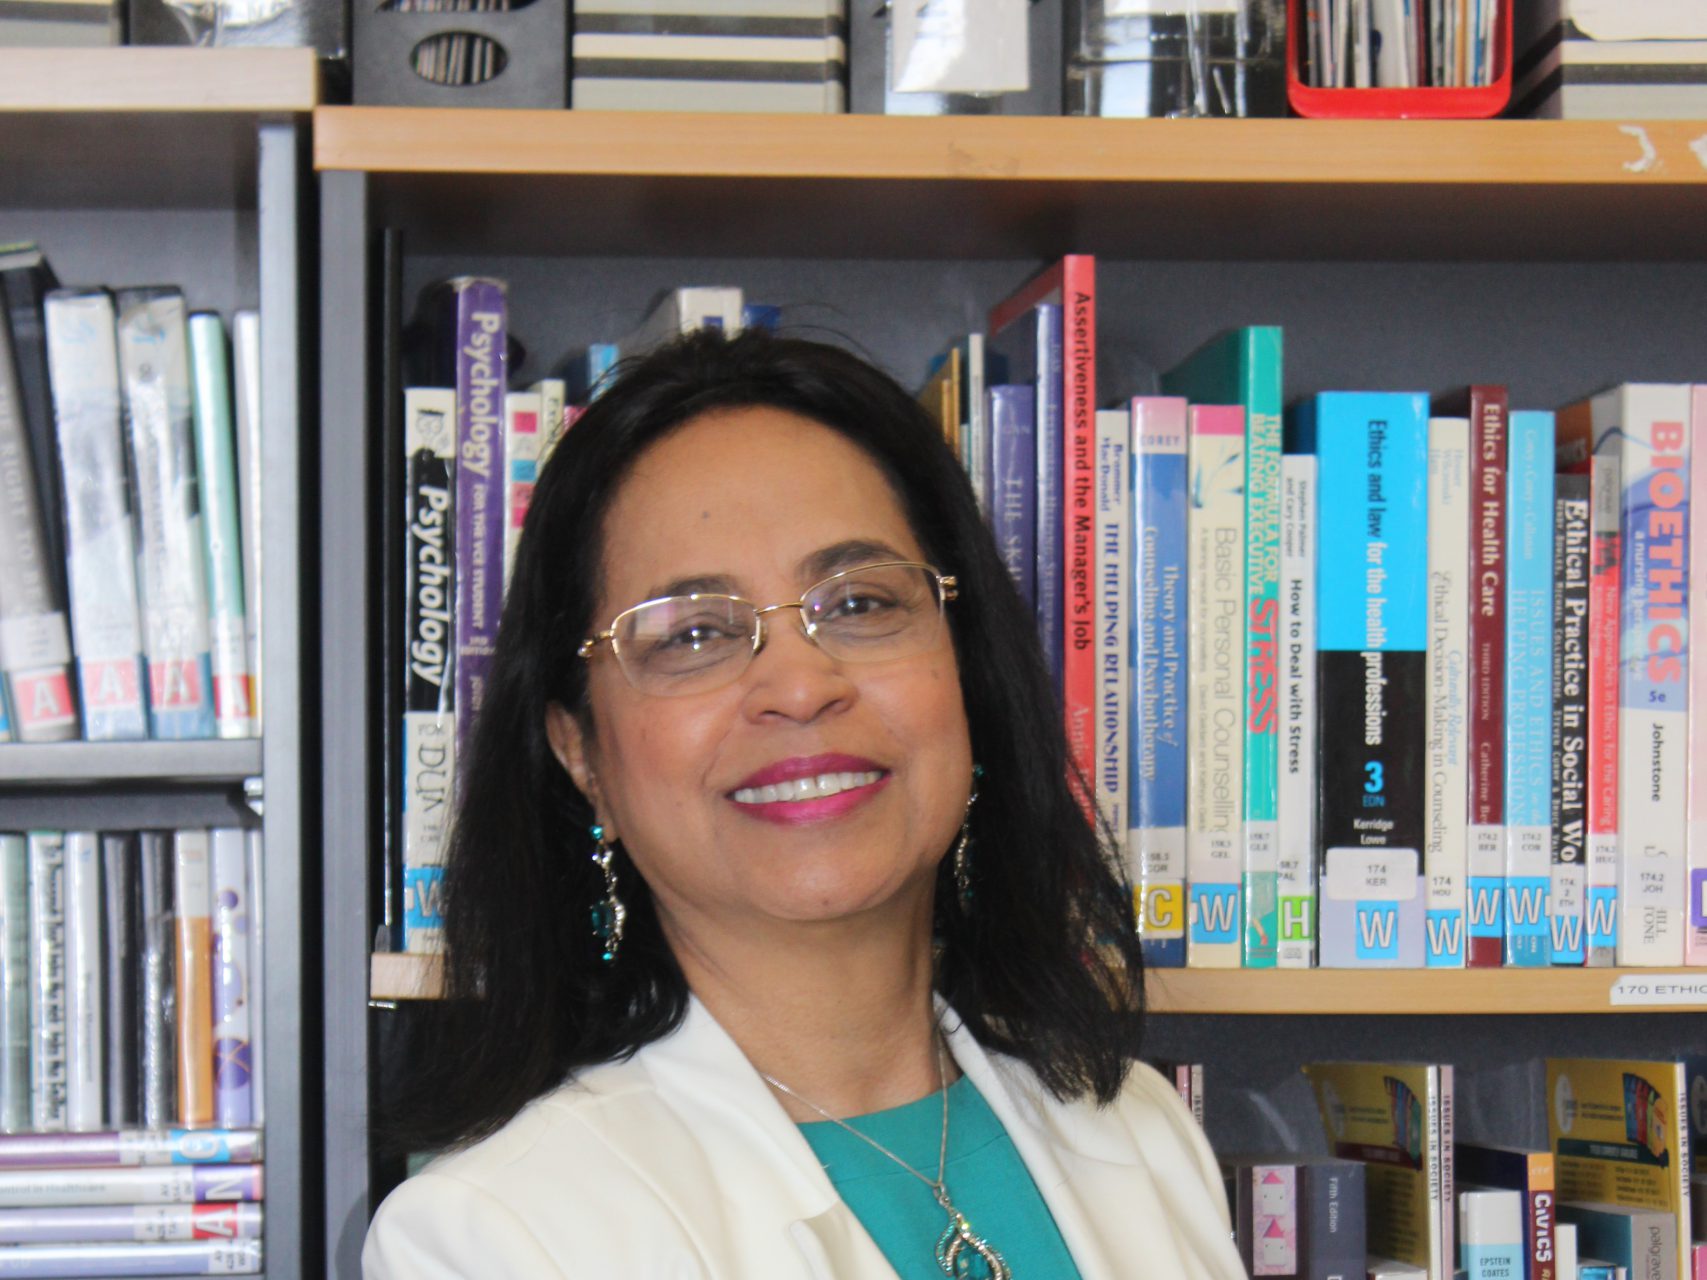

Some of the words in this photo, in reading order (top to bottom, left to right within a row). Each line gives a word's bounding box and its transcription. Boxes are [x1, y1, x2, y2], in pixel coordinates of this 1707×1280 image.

[1074, 292, 1091, 429] Assertiveness
[461, 311, 499, 478] Psychology
[1367, 420, 1387, 468] Ethics
[1482, 403, 1501, 461] Ethics
[1075, 436, 1090, 470] and
[1074, 476, 1091, 507] the
[1264, 451, 1280, 539] FORMULA
[1367, 474, 1386, 502] and
[1483, 467, 1500, 494] for
[473, 514, 484, 537] THE
[1105, 523, 1119, 559] THE
[1368, 508, 1387, 537] law
[1482, 501, 1500, 565] Health
[1214, 527, 1237, 591] Basic
[1249, 498, 1264, 595] EXECUTIVE
[1367, 542, 1387, 564] for
[1564, 499, 1589, 589] Ethical
[1647, 420, 1685, 685] BIOETHICS
[1072, 514, 1091, 614] Manager's
[1265, 546, 1278, 582] FOR
[1367, 569, 1387, 594] the
[411, 485, 450, 687] Psychology
[473, 569, 484, 629] STUDENT
[1161, 565, 1179, 622] Theory
[1289, 579, 1302, 616] How
[1481, 571, 1499, 616] Care
[1104, 563, 1119, 648] HELPING
[1367, 598, 1388, 648] health
[1072, 619, 1091, 650] Job
[1163, 626, 1179, 658] and
[1213, 599, 1236, 699] Personal
[1290, 622, 1301, 638] to
[1563, 597, 1589, 697] Practice
[1249, 598, 1280, 735] STRESS
[1289, 643, 1302, 679] Deal
[1162, 662, 1179, 729] Practice
[1290, 684, 1301, 721] with
[1361, 651, 1388, 746] professions
[1104, 654, 1119, 793] RELATIONSHIP
[1563, 705, 1584, 728] in
[1289, 726, 1301, 774] Stress
[1652, 723, 1664, 802] Johnstone
[1364, 761, 1384, 793] 3
[1561, 736, 1584, 810] Social
[1354, 818, 1394, 831] Kerridge
[1361, 834, 1386, 845] Lowe
[1366, 878, 1386, 886] KER
[1148, 889, 1172, 927] C
[1200, 894, 1236, 932] W
[1283, 901, 1309, 939] H
[1509, 887, 1542, 924] W
[1359, 911, 1395, 949] W
[1426, 918, 1460, 955] W
[1618, 986, 1648, 994] 170
[1329, 1201, 1338, 1233] Edition
[1534, 1193, 1553, 1263] CIVICS
[1647, 1226, 1662, 1280] palgrave
